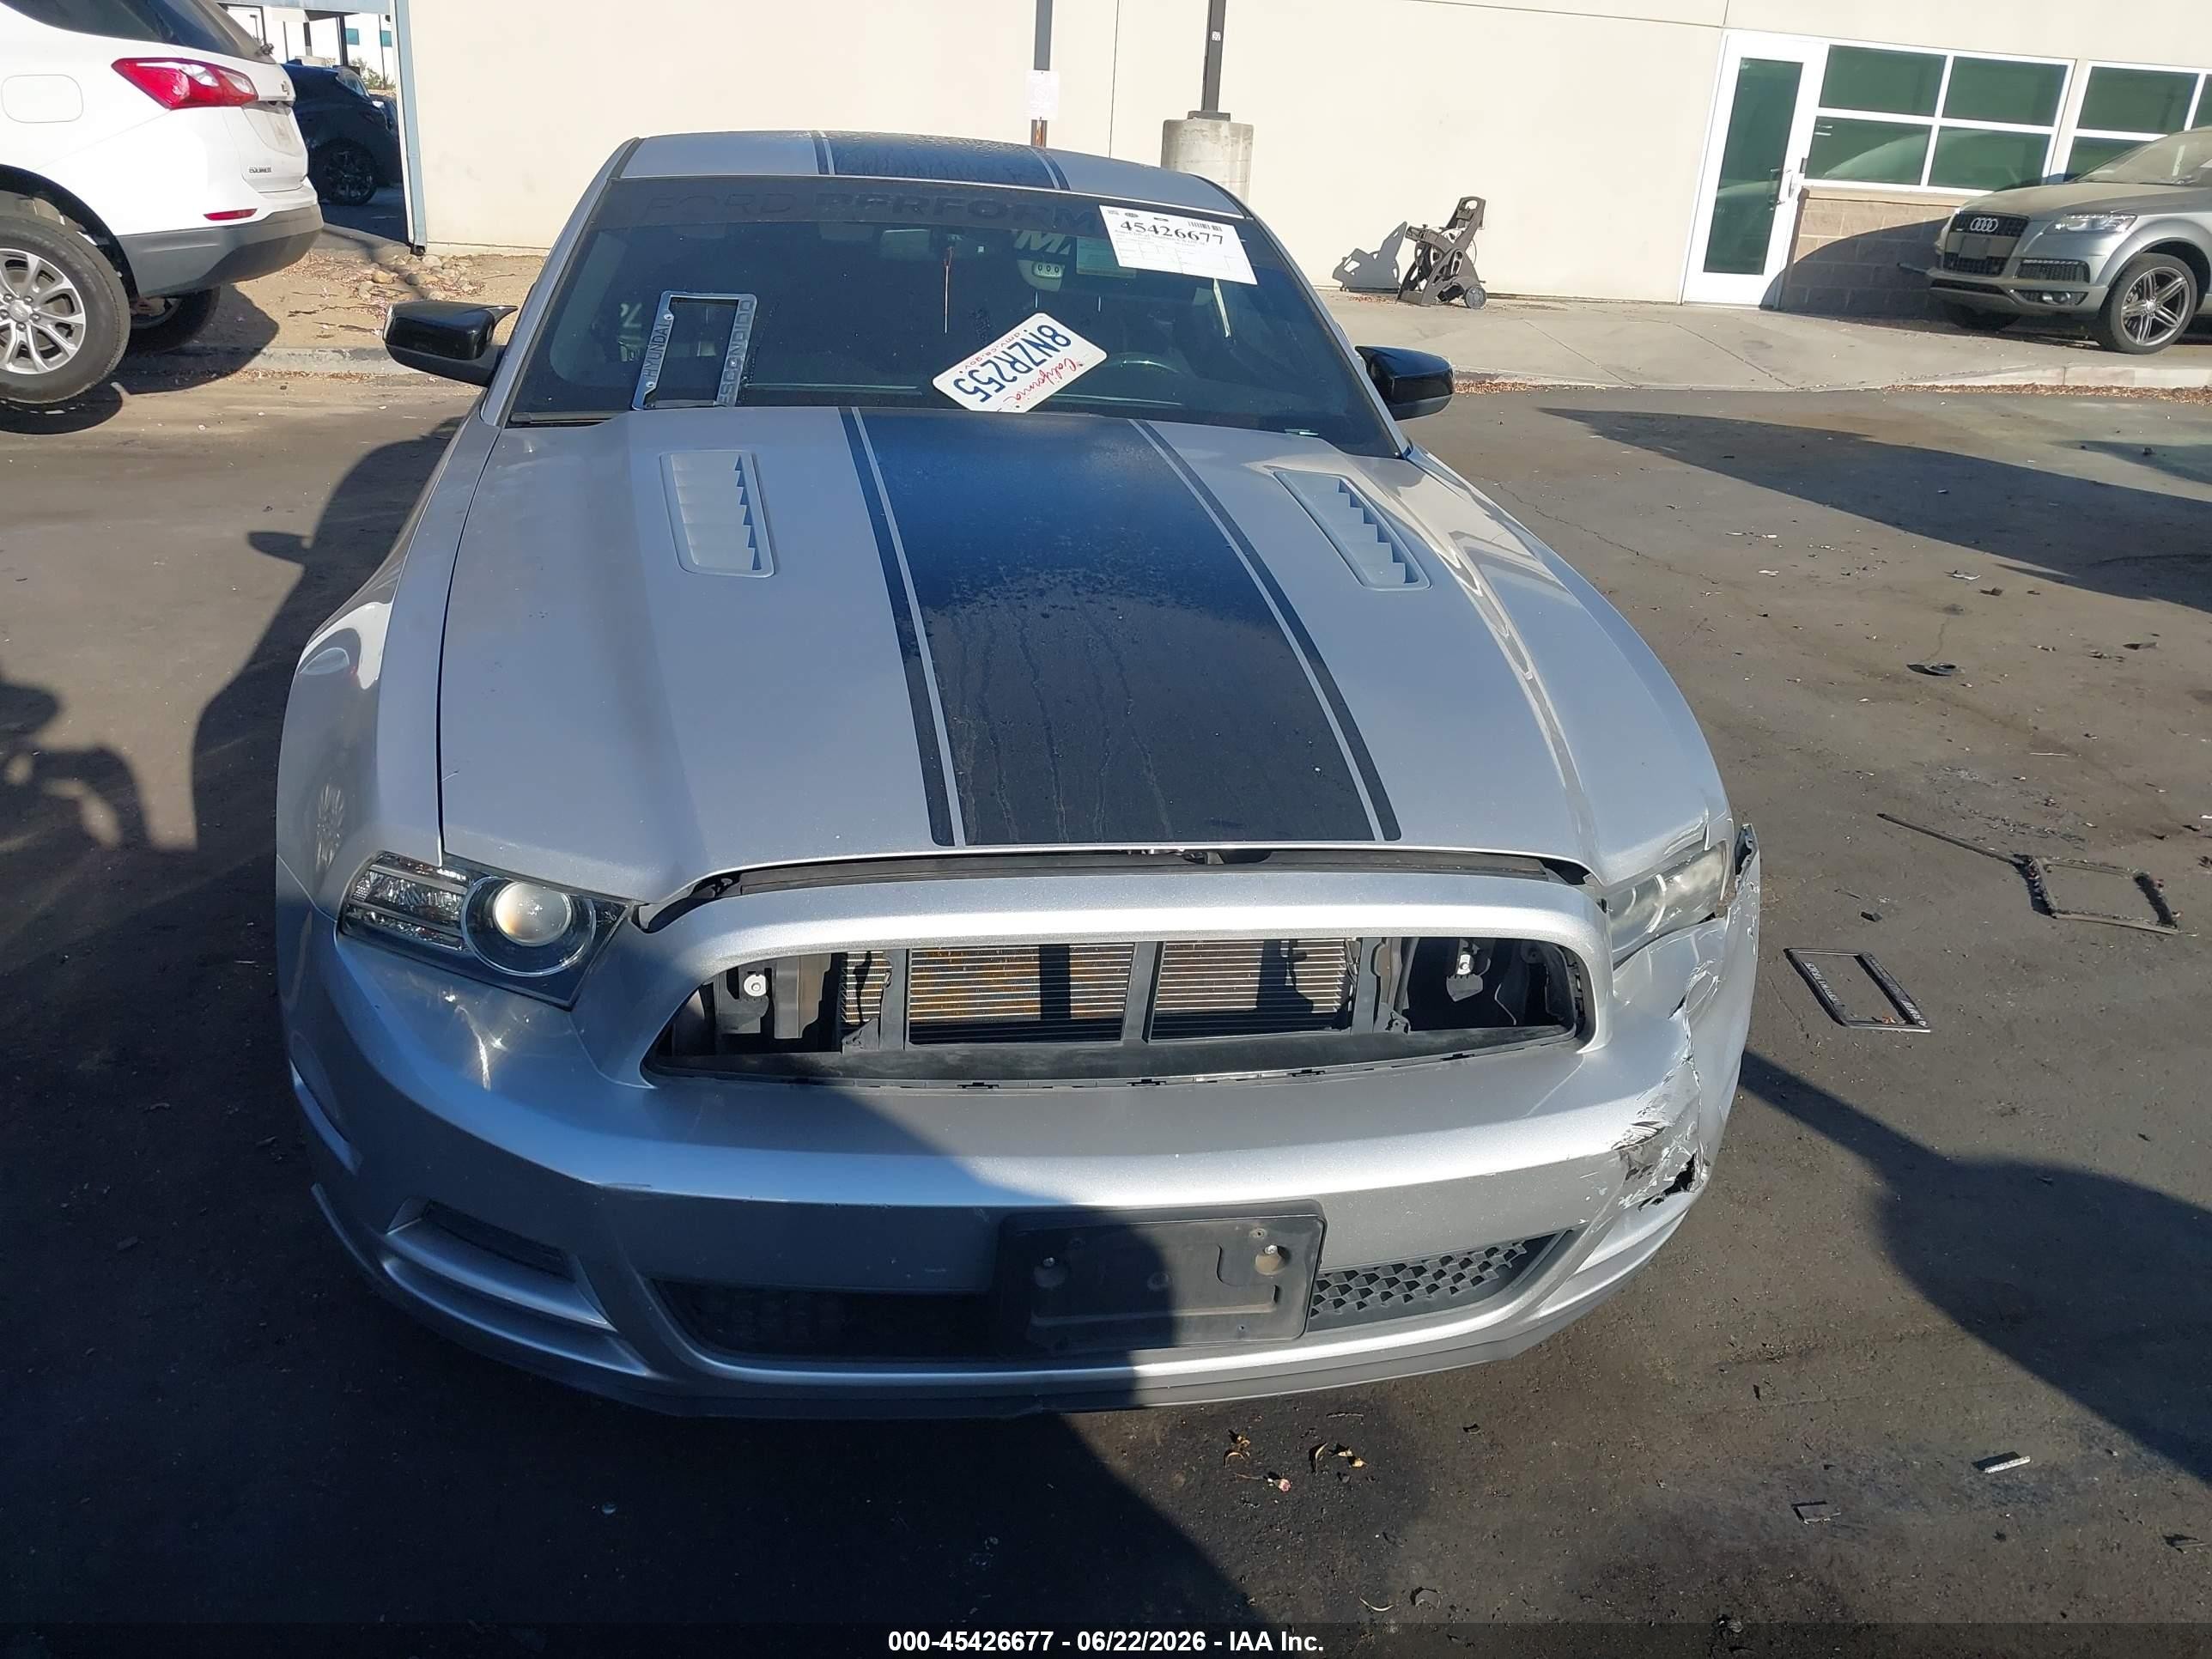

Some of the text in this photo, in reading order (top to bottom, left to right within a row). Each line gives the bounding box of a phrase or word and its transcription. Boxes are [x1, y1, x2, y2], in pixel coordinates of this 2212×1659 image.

[817, 191, 1099, 229] PERFORM
[1120, 221, 1224, 245] 45426677
[642, 320, 671, 379] HYUNDAI
[719, 300, 751, 404] ESCONDIDO
[953, 325, 1072, 403] 8NZR255
[964, 332, 1021, 370] dmv.ca.gov
[1003, 357, 1079, 401] California
